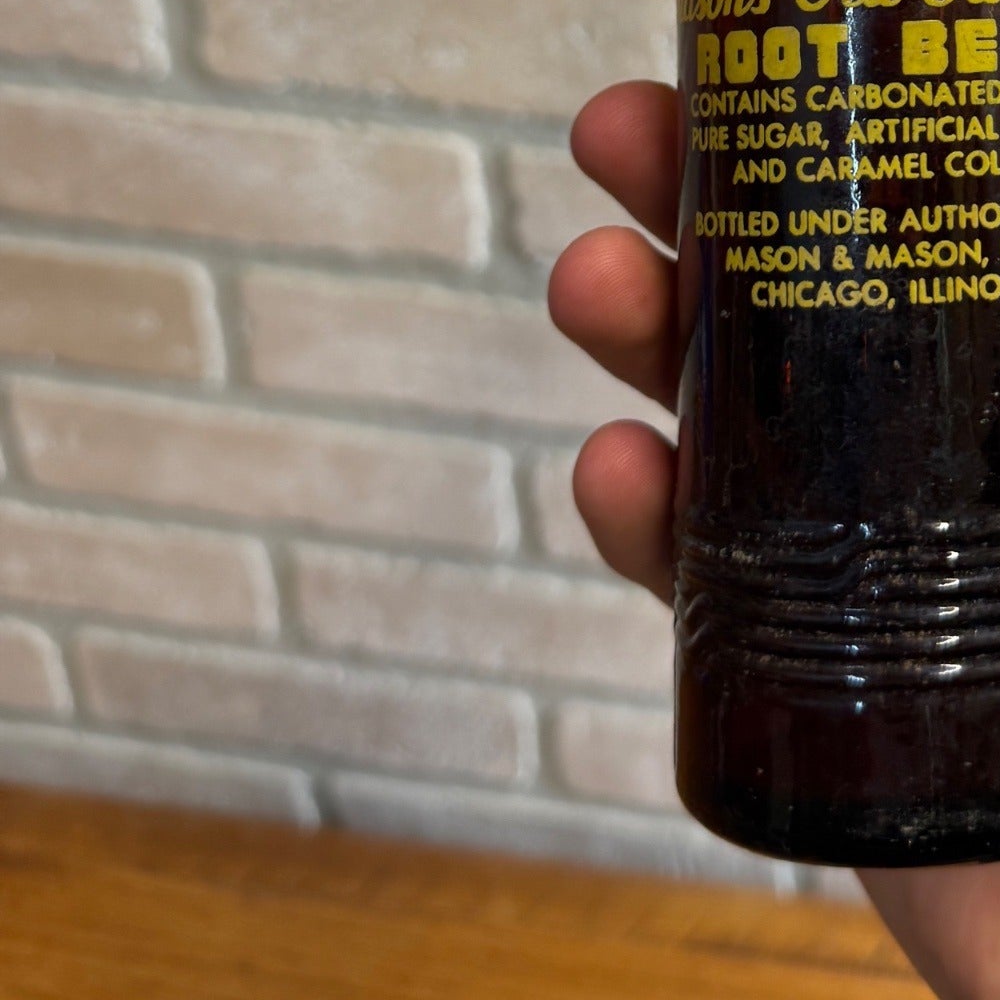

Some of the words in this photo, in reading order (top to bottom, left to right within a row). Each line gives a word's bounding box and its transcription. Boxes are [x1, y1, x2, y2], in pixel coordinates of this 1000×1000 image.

[696, 23, 848, 86] ROOT
[690, 86, 797, 118] CONTAINS
[691, 125, 729, 151] PURE
[736, 121, 830, 151] SUGAR,
[845, 114, 999, 145] ARTIFICIAL
[733, 158, 787, 185] AND
[796, 152, 934, 183] CARAMEL
[695, 211, 780, 237] BOTTLED
[788, 207, 888, 236] UNDER
[725, 245, 821, 273] MASON
[832, 245, 855, 271] &
[865, 238, 989, 269] MASON,
[751, 278, 896, 310] CHICAGO,
